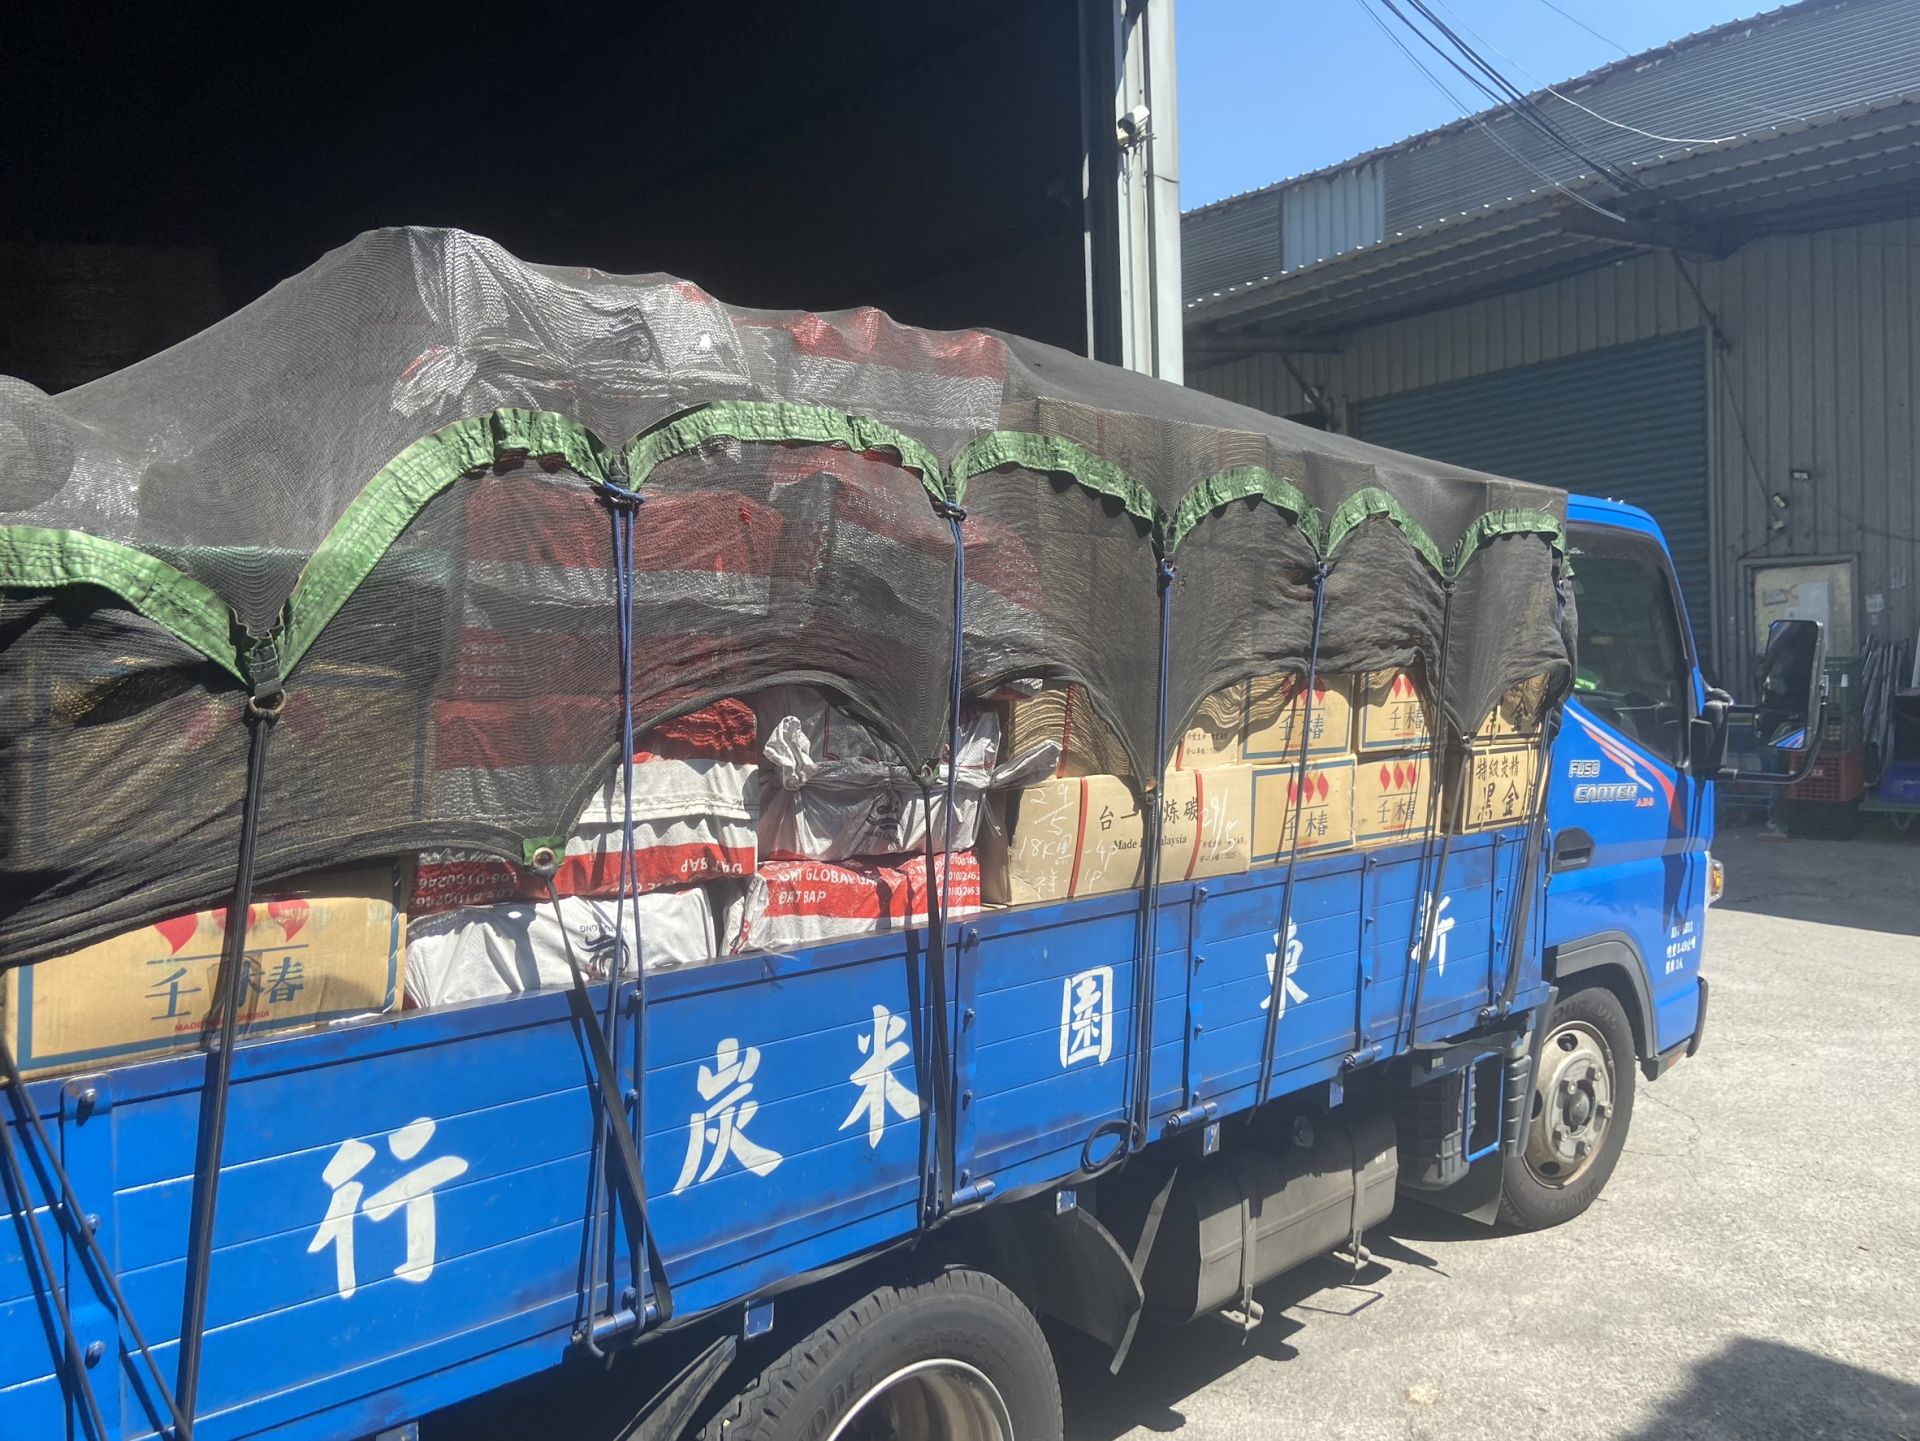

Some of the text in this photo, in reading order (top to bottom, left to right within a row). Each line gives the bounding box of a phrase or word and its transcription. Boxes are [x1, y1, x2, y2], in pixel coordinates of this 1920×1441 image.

[1569, 760, 1600, 778] FUSO
[1575, 783, 1638, 803] CANTER
[1100, 797, 1198, 831] 台一炼碳
[806, 868, 854, 885] GLOBAL
